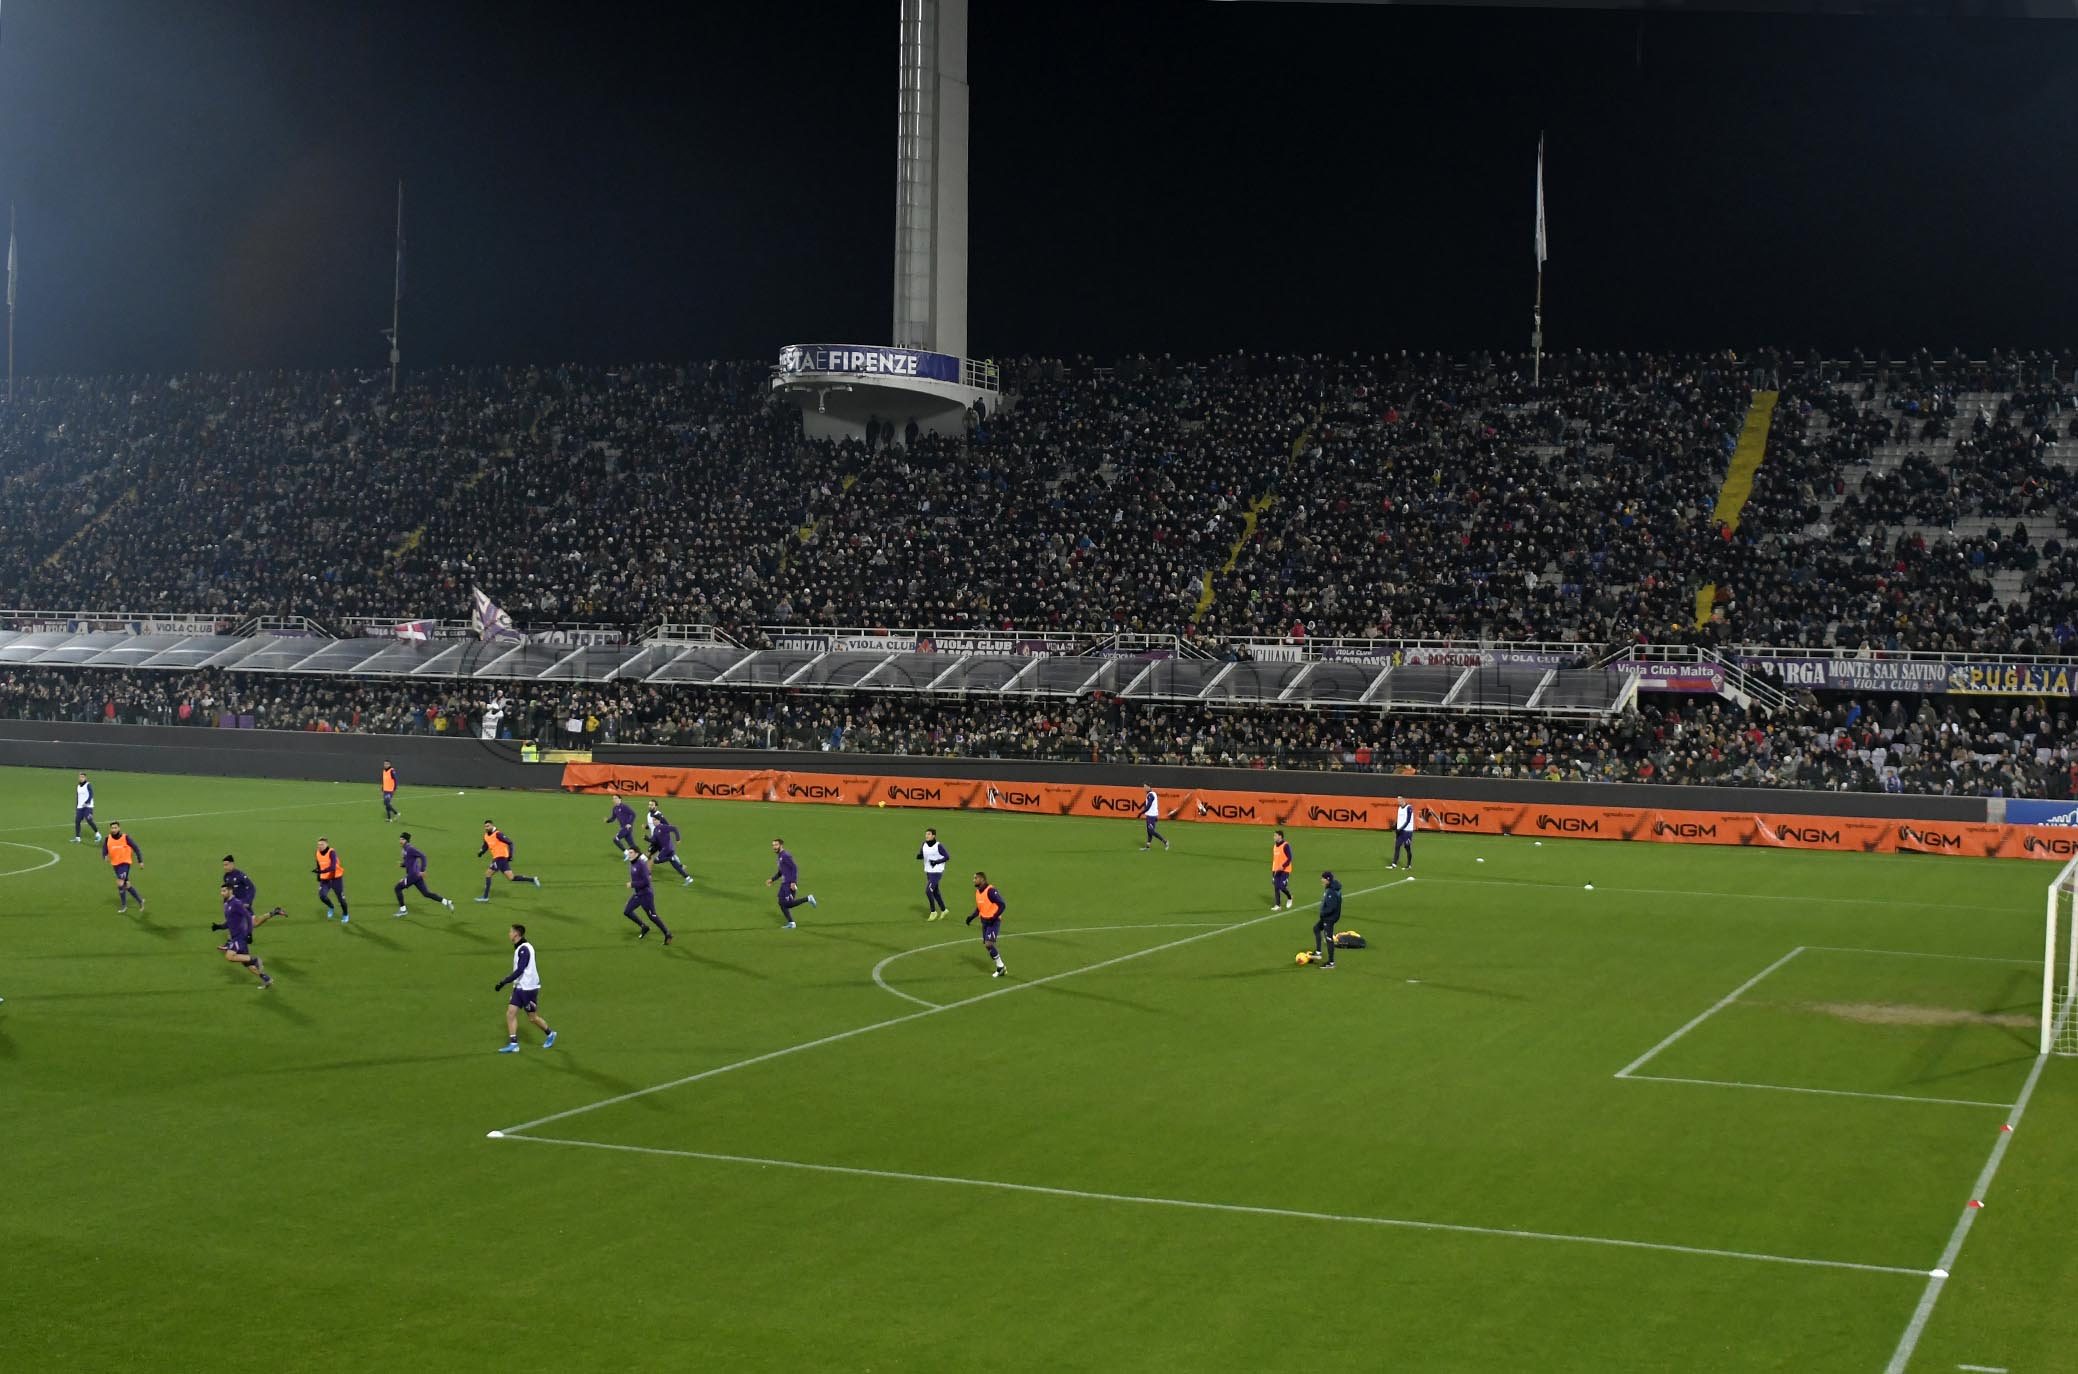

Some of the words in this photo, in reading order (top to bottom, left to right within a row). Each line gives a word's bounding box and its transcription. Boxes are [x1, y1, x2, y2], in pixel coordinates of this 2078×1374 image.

[829, 351, 917, 375] FIRENZE
[849, 640, 885, 650] VIOLA
[886, 641, 916, 651] CLUB
[935, 639, 974, 650] VIOLA
[977, 641, 1013, 650] CLUB
[1428, 653, 1481, 667] BARCELLONA
[1501, 654, 1534, 663] VIOLA
[1617, 664, 1647, 675] Viola
[1650, 665, 1677, 675] Club
[1680, 666, 1714, 676] Malta
[1828, 661, 1871, 678] MONTE
[1873, 663, 1898, 679] SAN
[1901, 663, 1946, 681] SAVINO
[1853, 678, 1886, 690] VIOLA
[1890, 679, 1920, 691] CLUB
[1970, 669, 2068, 689] PUGLIA
[701, 782, 745, 796] NGM
[794, 785, 840, 800] NGM
[895, 786, 941, 801] NGM
[997, 788, 1040, 806] NGM
[1206, 803, 1255, 819] NGM
[1317, 808, 1367, 822] NGM
[1428, 808, 1479, 826] NGM
[1545, 816, 1599, 833] NGM
[1662, 823, 1716, 838] NGM
[1784, 828, 1840, 844] NGM
[1906, 828, 1961, 849] NGM
